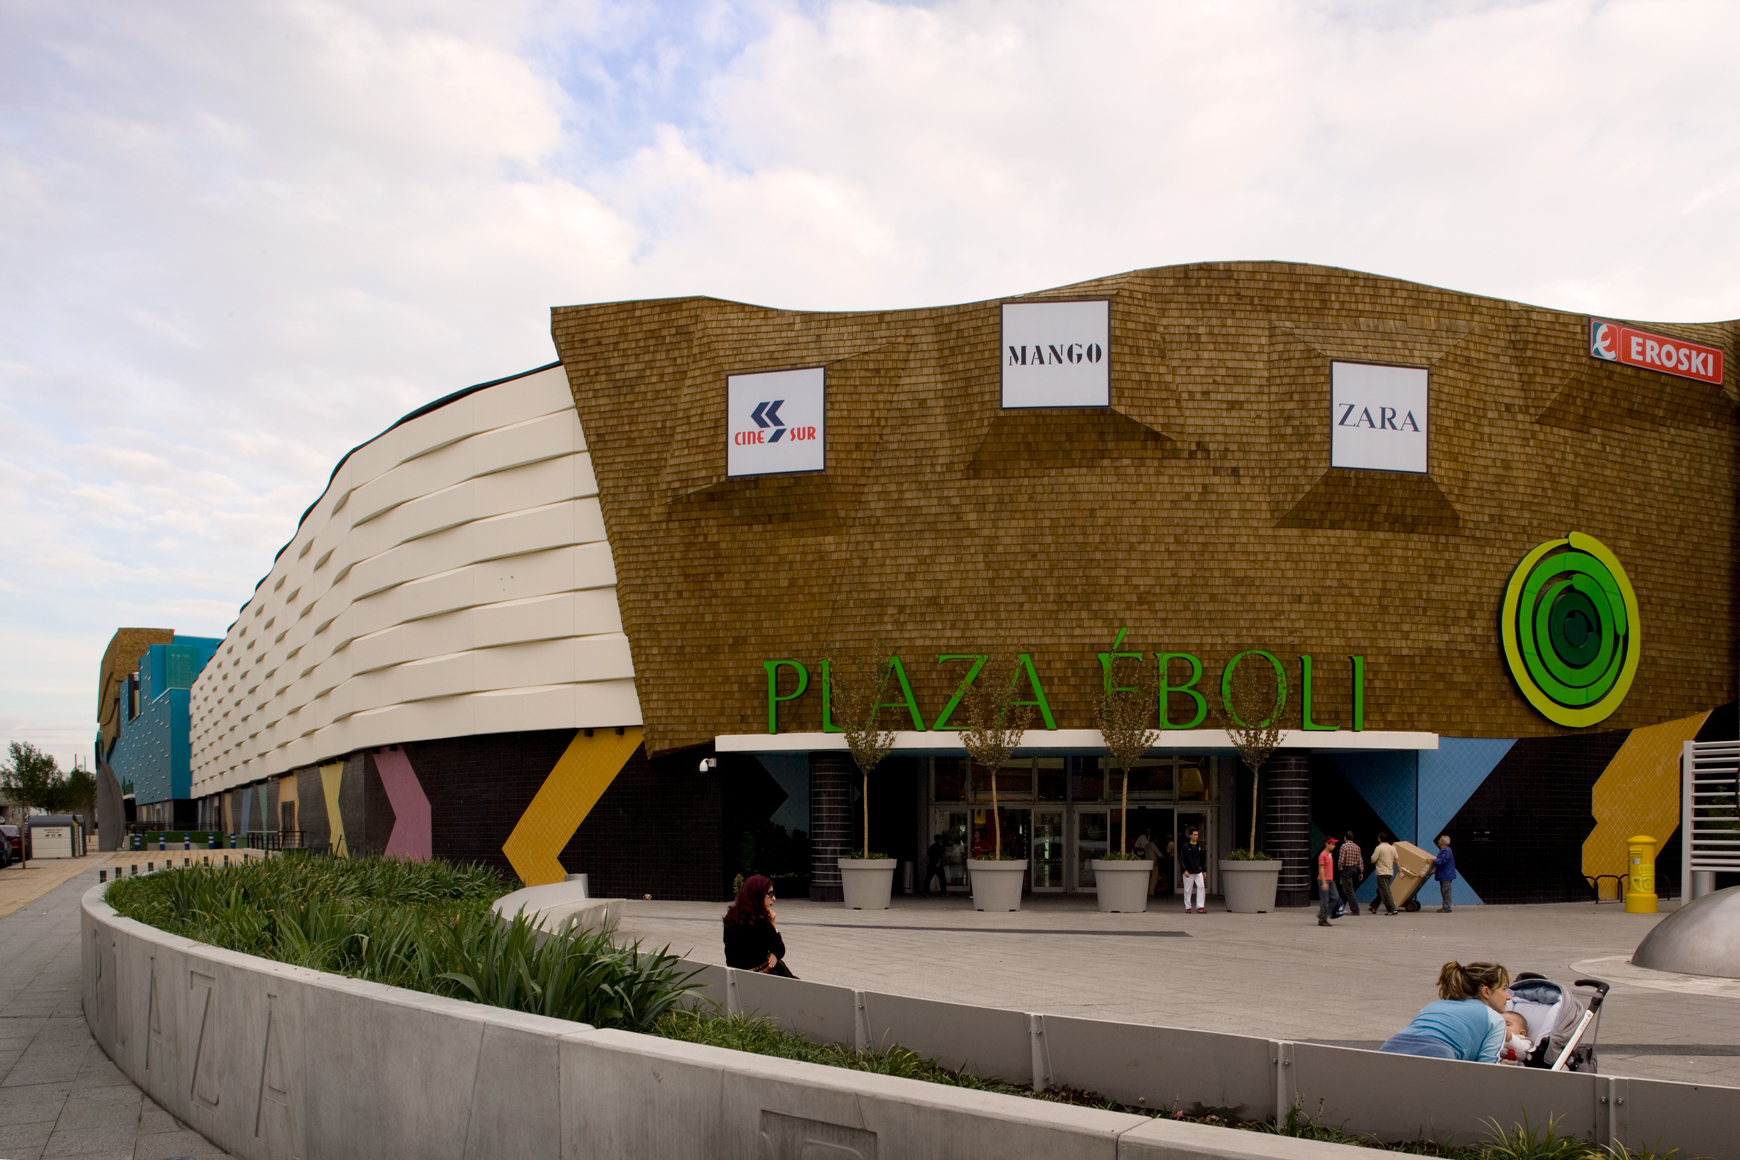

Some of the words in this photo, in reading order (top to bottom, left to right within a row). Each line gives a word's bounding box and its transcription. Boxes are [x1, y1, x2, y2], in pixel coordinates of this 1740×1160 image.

[1008, 343, 1102, 366] MANGO
[1630, 336, 1714, 377] EROSKI
[1337, 402, 1421, 433] ZARA
[734, 430, 765, 446] CINE
[790, 426, 816, 442] SUR
[763, 654, 1058, 734] PLAZA
[1097, 626, 1364, 731] ÉBOLI
